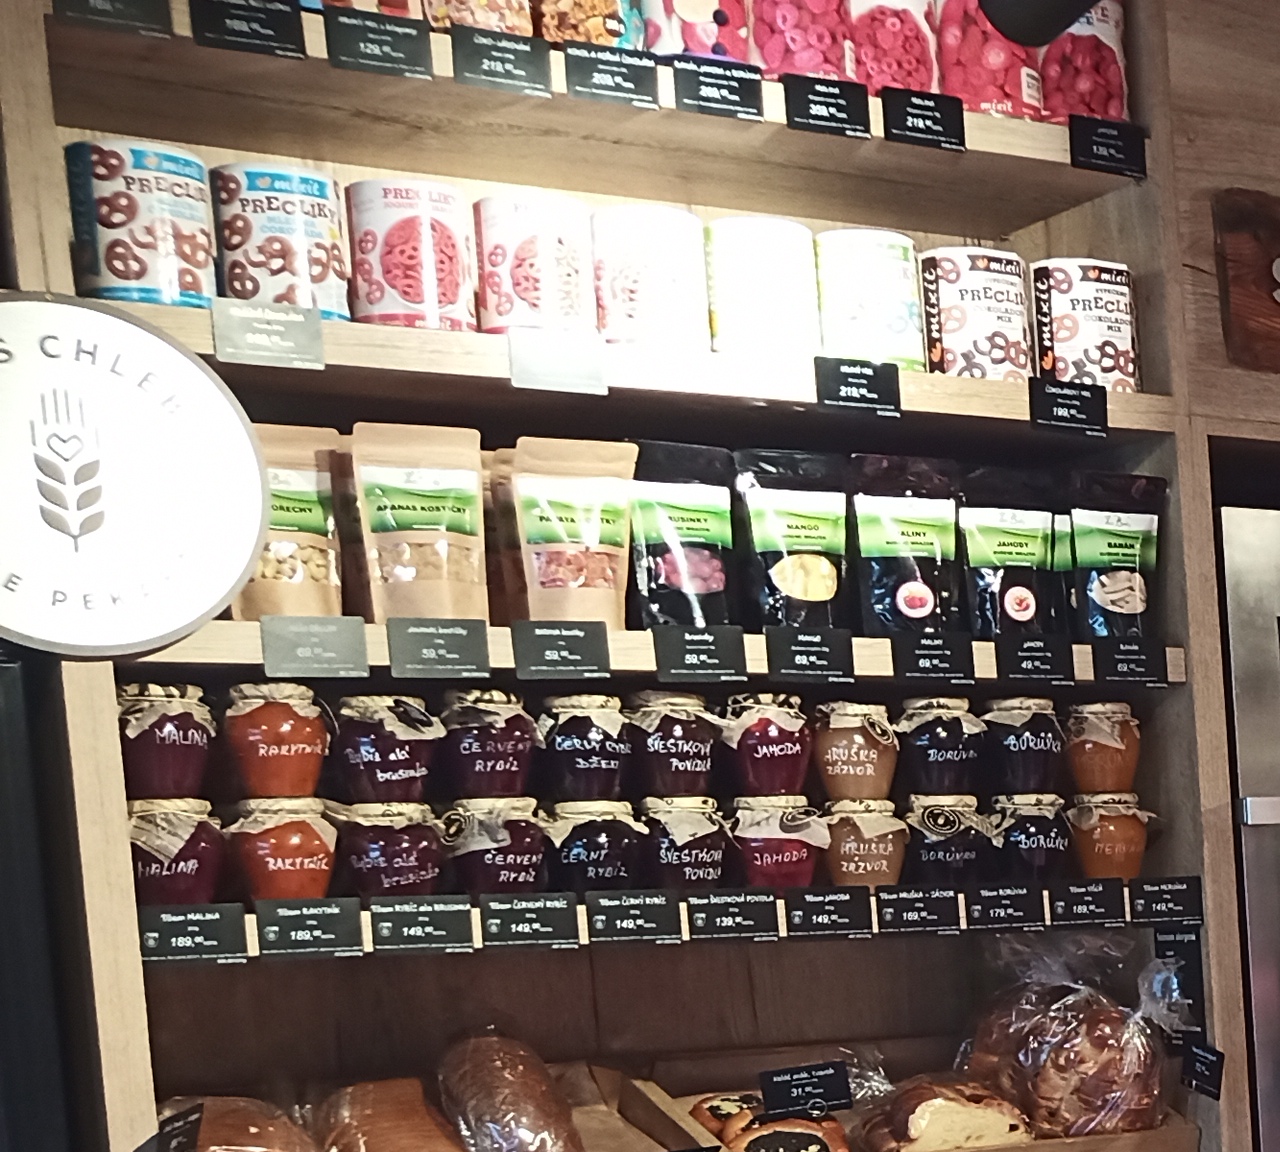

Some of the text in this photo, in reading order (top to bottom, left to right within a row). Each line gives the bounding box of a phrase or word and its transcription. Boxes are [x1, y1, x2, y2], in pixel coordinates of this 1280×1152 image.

[273, 180, 321, 196] miit
[787, 523, 820, 532] MANGO
[753, 742, 802, 759] JAHODA
[753, 849, 808, 866] JAHODA
